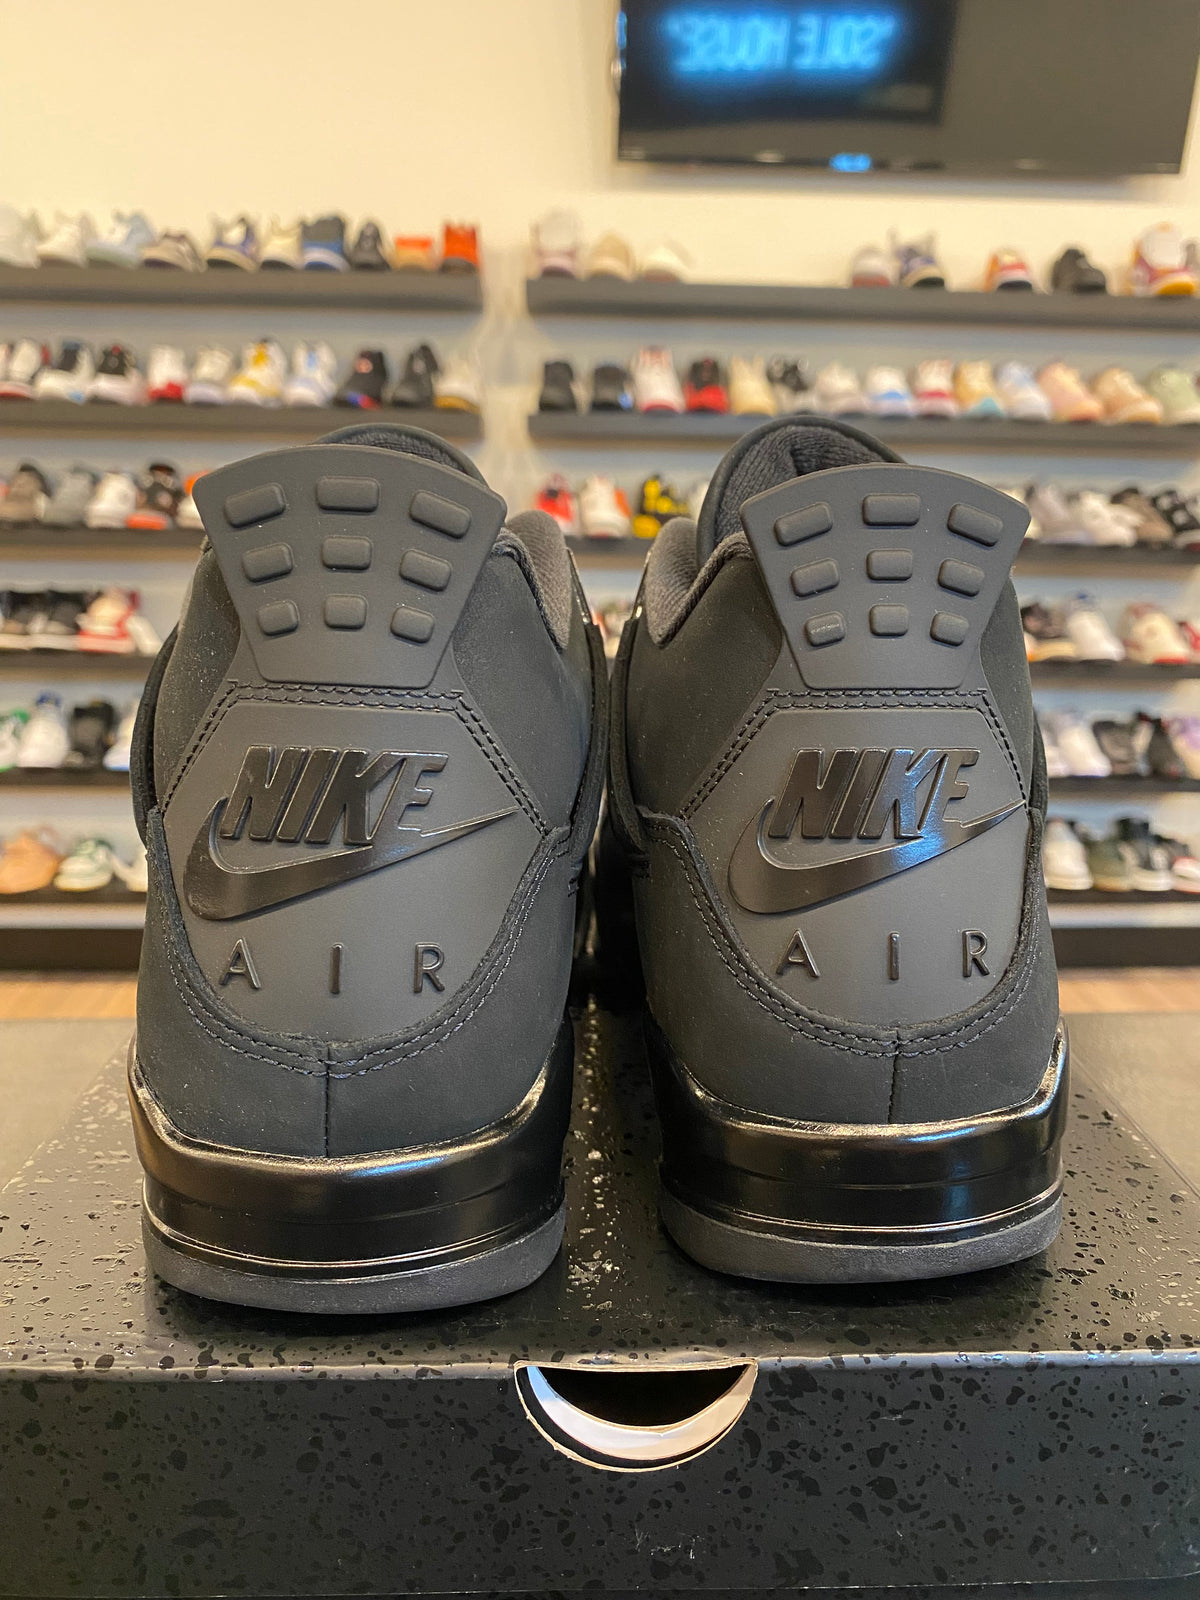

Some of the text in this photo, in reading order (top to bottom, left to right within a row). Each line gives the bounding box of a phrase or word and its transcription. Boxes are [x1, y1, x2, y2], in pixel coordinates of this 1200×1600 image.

[220, 744, 449, 845] NIKE
[768, 748, 980, 840] NIKE
[219, 937, 445, 994] AIR
[776, 929, 990, 980] AIR
